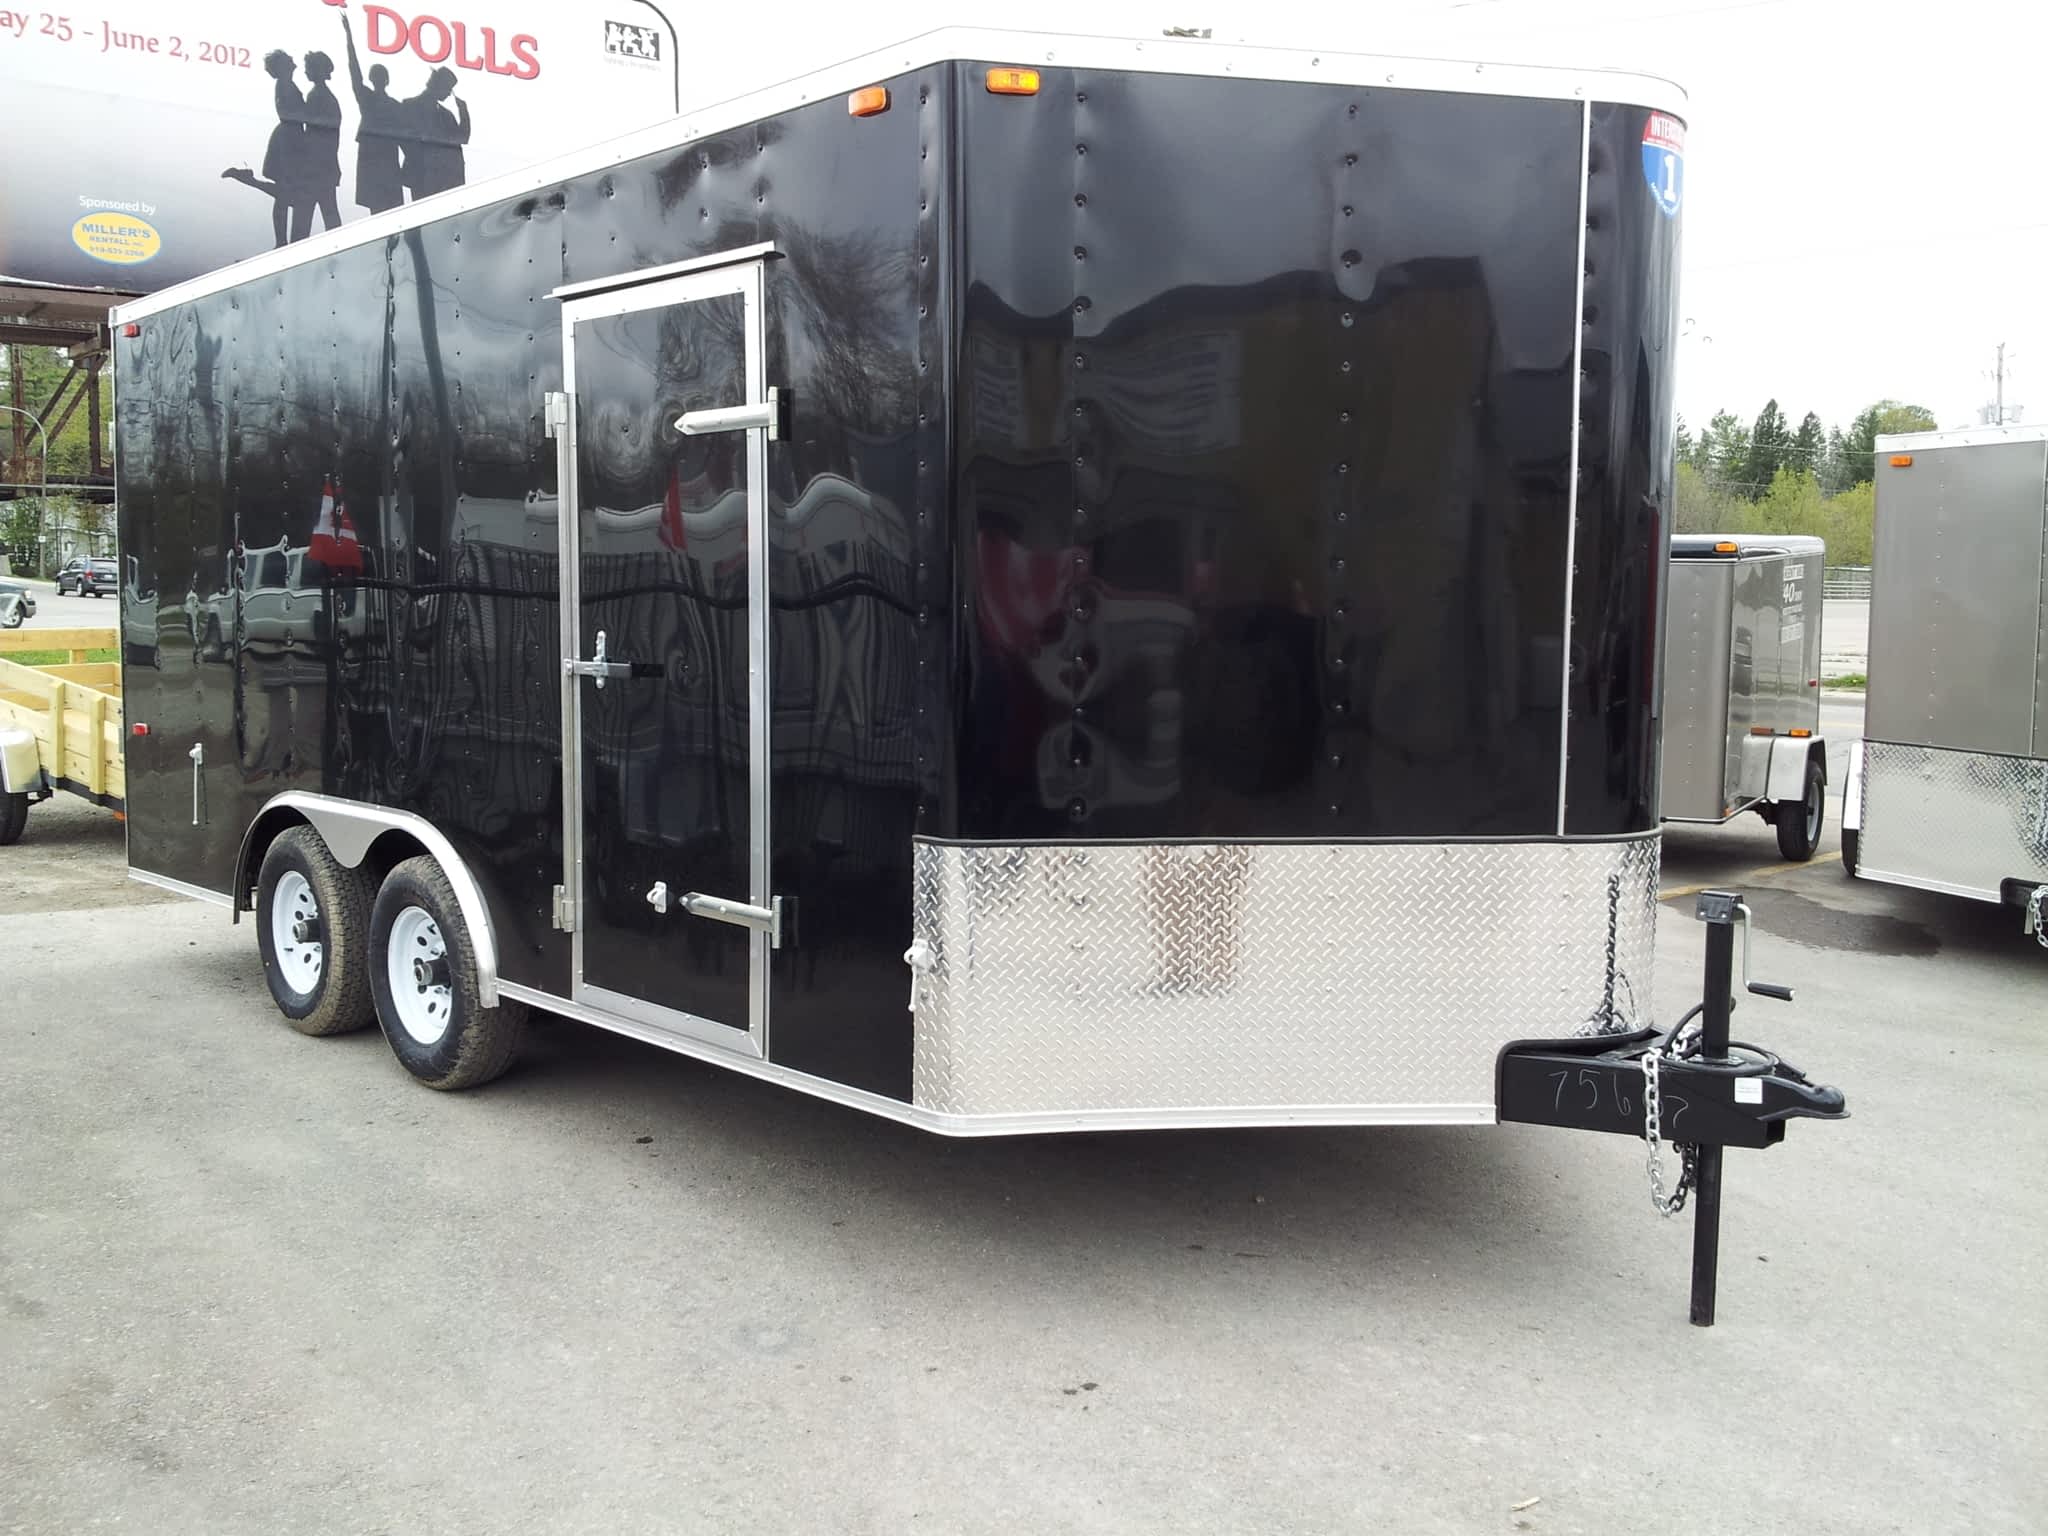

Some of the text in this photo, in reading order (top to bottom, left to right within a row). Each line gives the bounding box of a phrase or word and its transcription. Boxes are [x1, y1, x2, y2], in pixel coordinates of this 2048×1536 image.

[40, 13, 73, 41] 25
[101, 20, 159, 52] June
[169, 36, 190, 62] 2,
[199, 41, 251, 68] 2012
[363, 4, 541, 80] DOLLS
[80, 195, 156, 216] Sponsored by
[81, 223, 151, 239] MILLER'S
